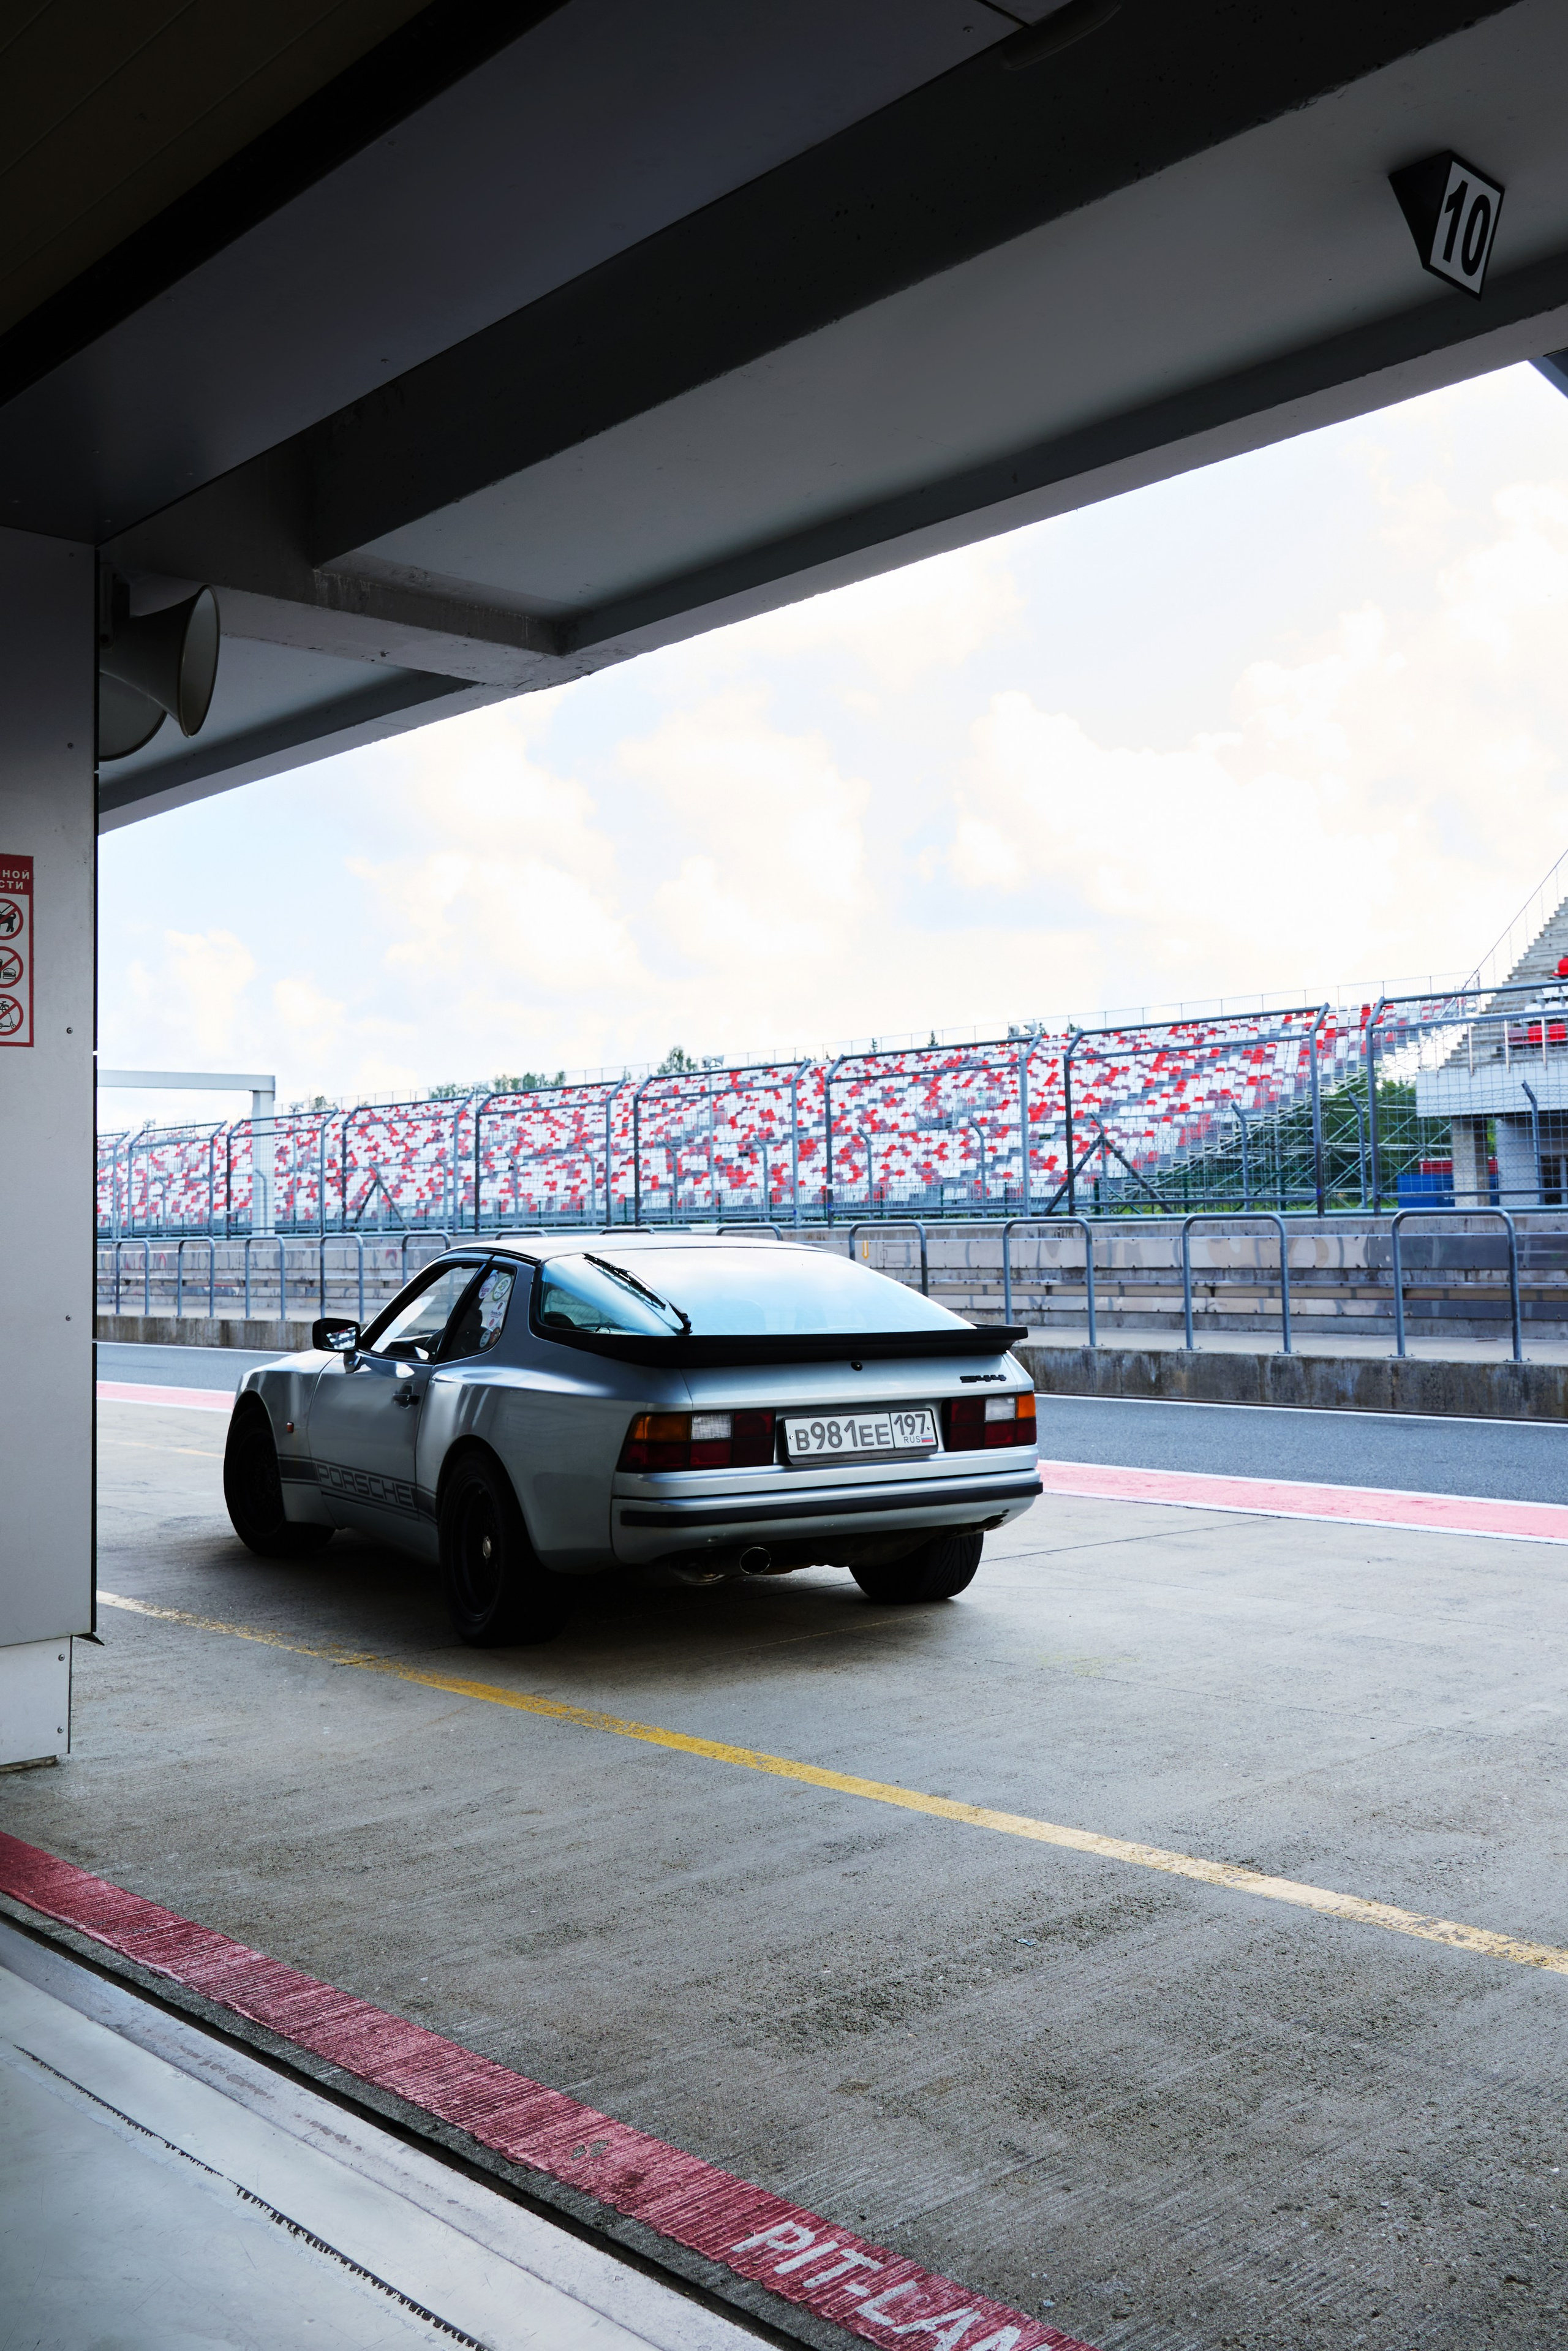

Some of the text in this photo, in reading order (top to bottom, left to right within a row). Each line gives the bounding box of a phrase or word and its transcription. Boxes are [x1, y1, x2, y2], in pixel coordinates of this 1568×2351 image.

[1442, 179, 1491, 276] 10
[2, 870, 29, 880] НОЙ
[960, 1375, 1006, 1383] 944
[894, 1413, 925, 1435] 197
[317, 1463, 413, 1508] PORSCHE
